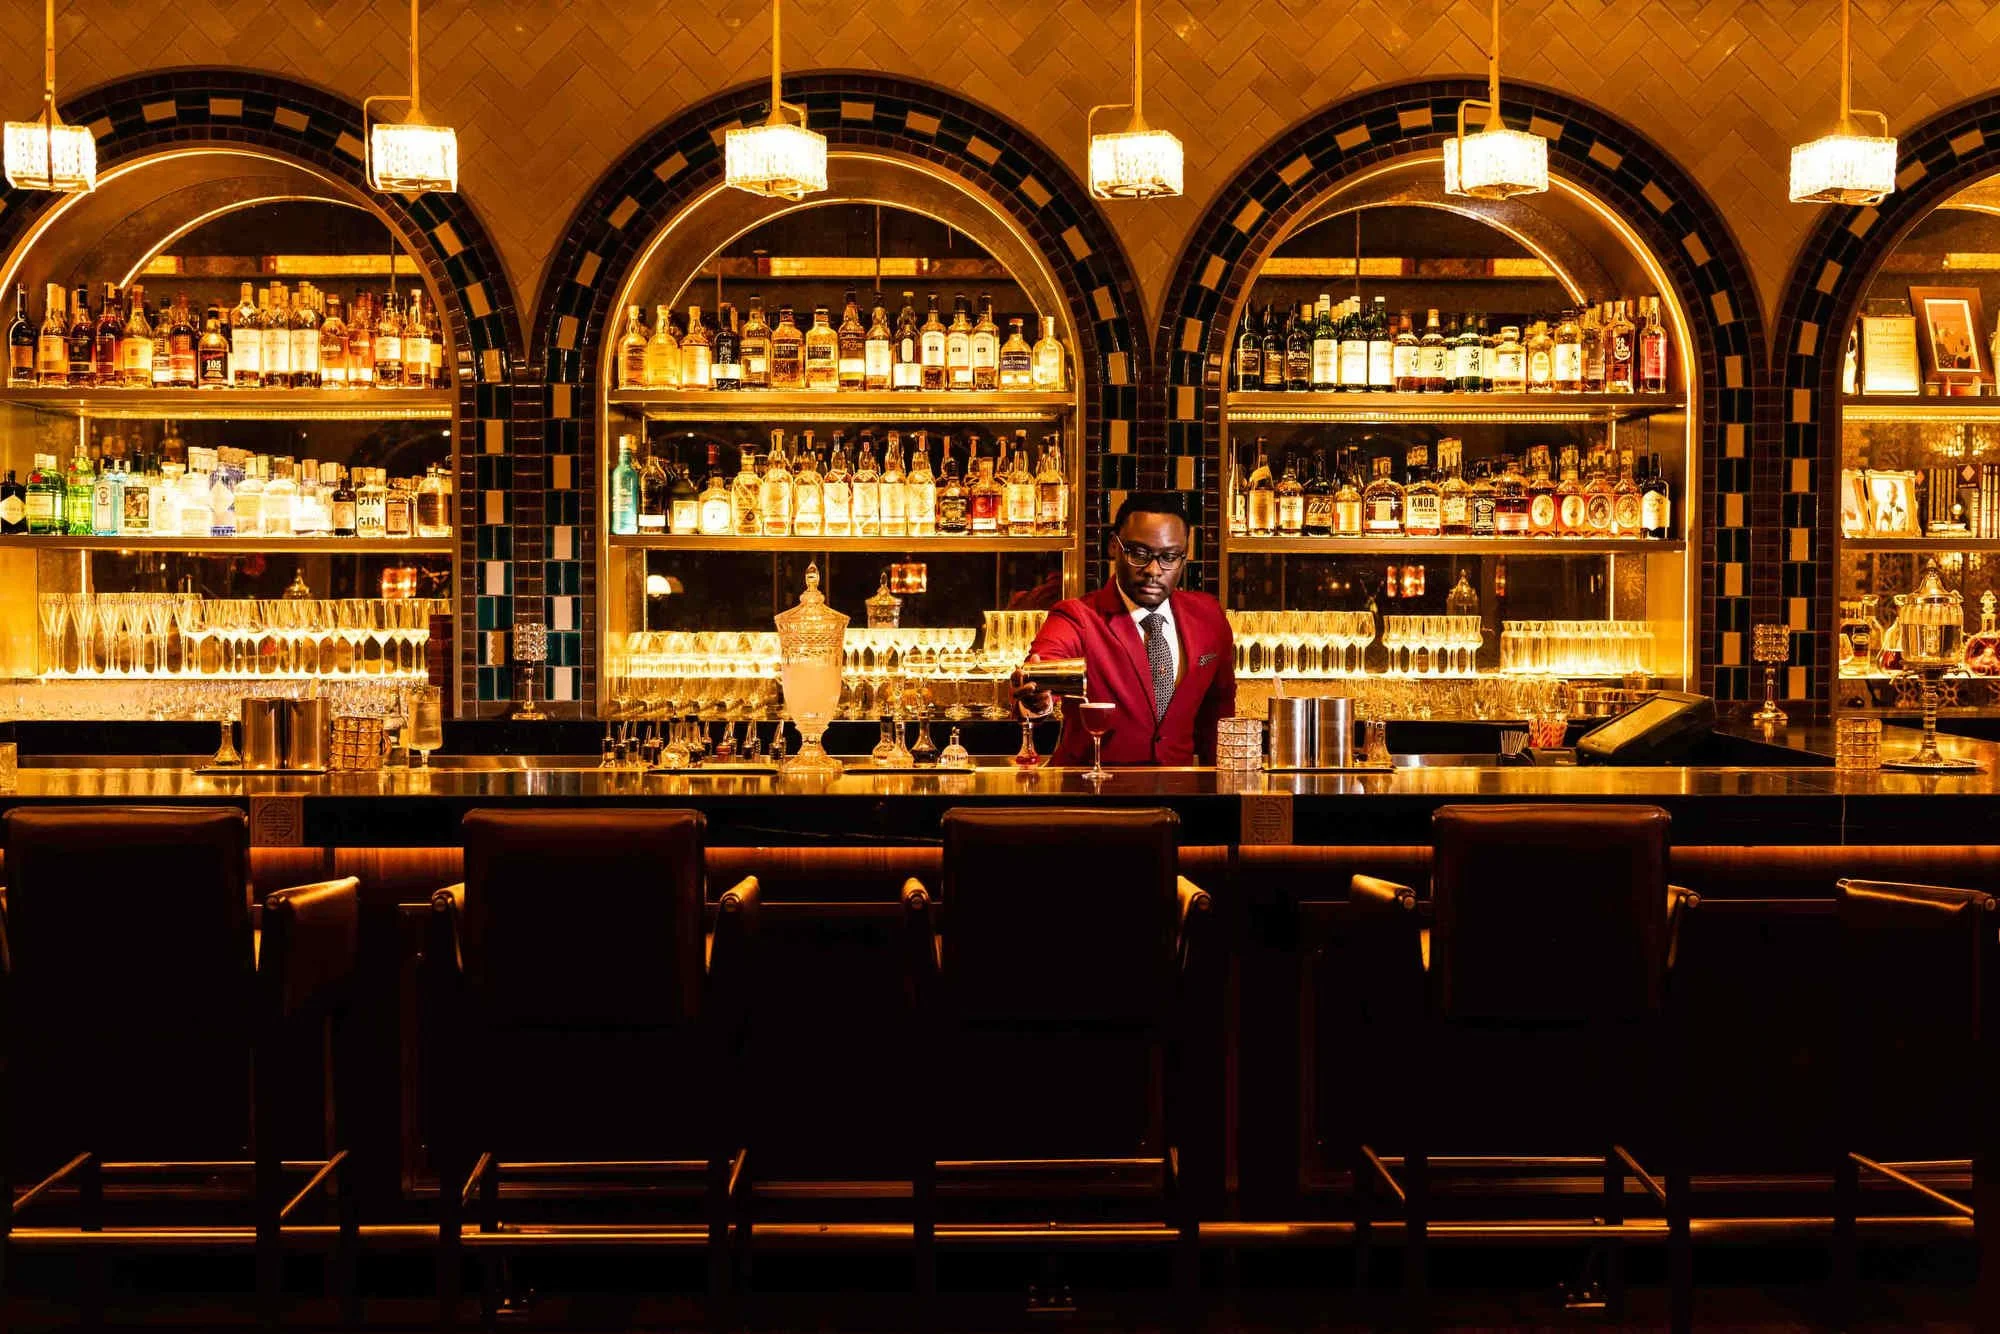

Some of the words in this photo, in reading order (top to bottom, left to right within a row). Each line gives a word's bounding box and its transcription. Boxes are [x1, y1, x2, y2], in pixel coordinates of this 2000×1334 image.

[206, 359, 222, 369] 105
[358, 497, 381, 505] GIN
[1412, 497, 1435, 507] KNOB
[1308, 502, 1330, 513] 1776
[358, 517, 381, 525] GIN
